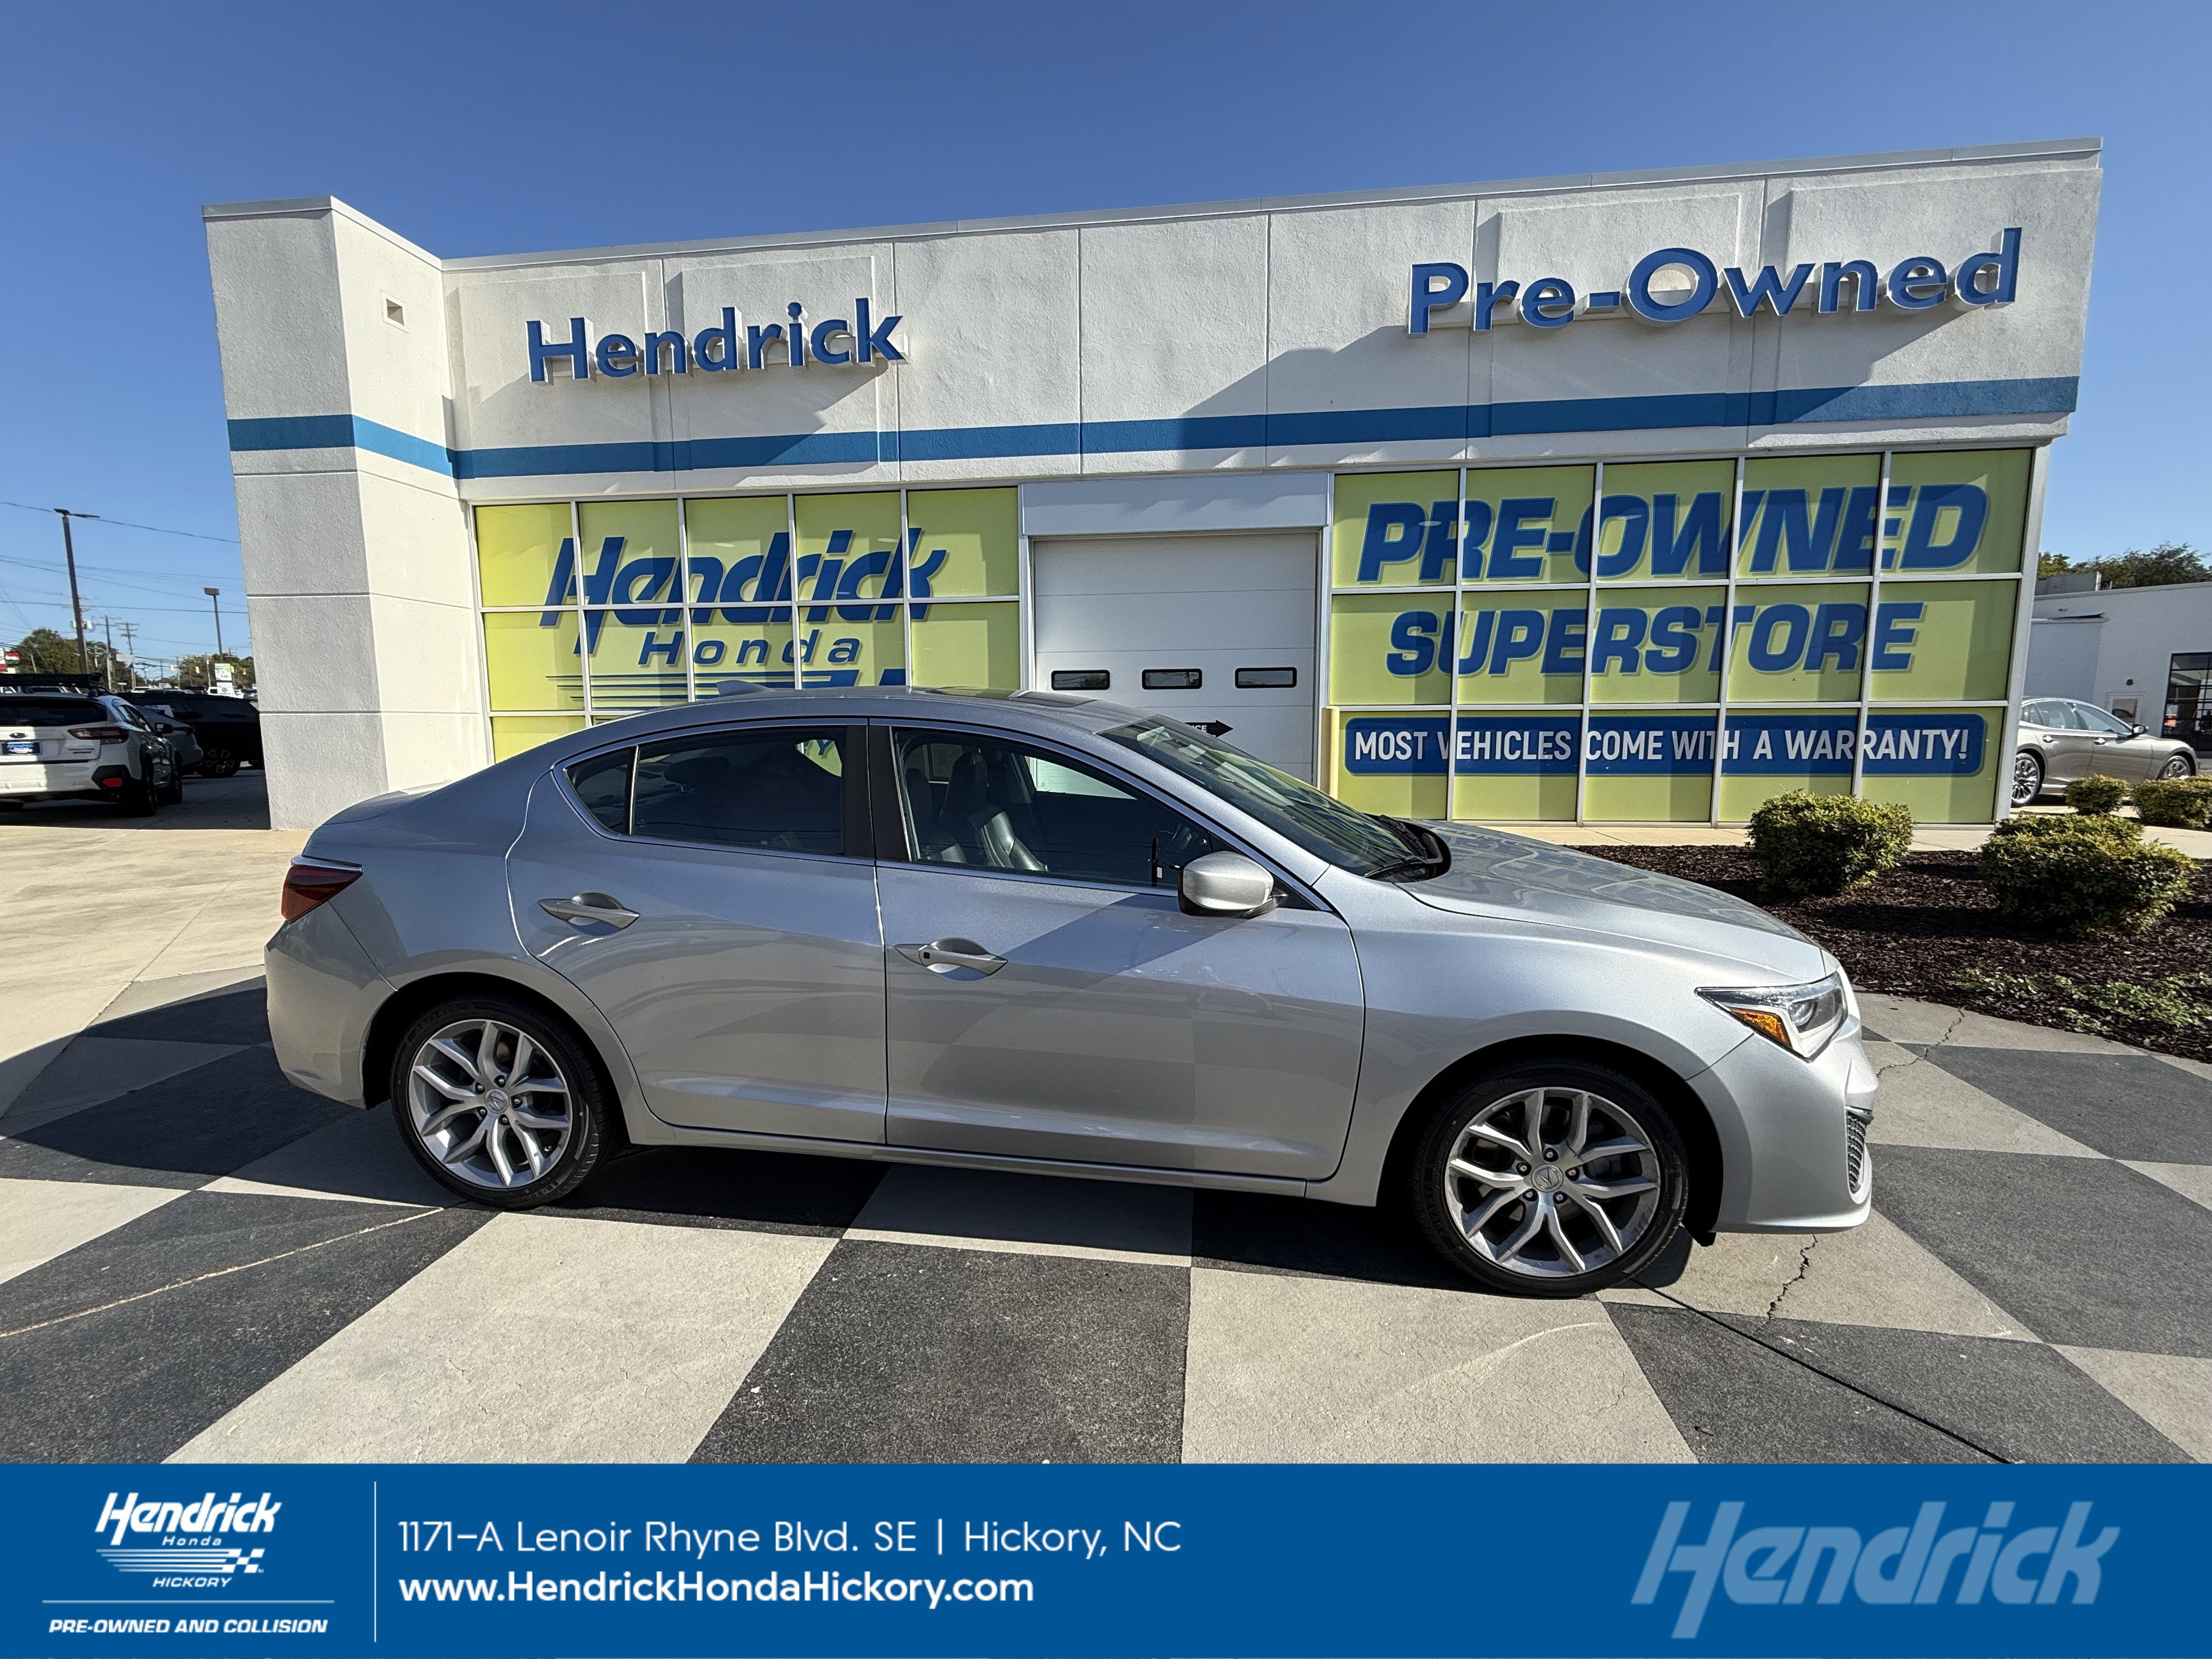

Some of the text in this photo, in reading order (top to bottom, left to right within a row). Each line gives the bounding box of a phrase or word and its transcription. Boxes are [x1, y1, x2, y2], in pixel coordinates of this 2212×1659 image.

[1408, 228, 2022, 334] Pre-Owned
[526, 298, 902, 382] Hendrick
[1358, 484, 1988, 583] PRE-OWNED
[539, 528, 946, 654] Hendrick
[639, 629, 860, 664] Honda
[1386, 602, 1923, 676] SUPERSTORE
[1355, 729, 1969, 760] MOST VEHICLES COME WITH A WARRANTY!
